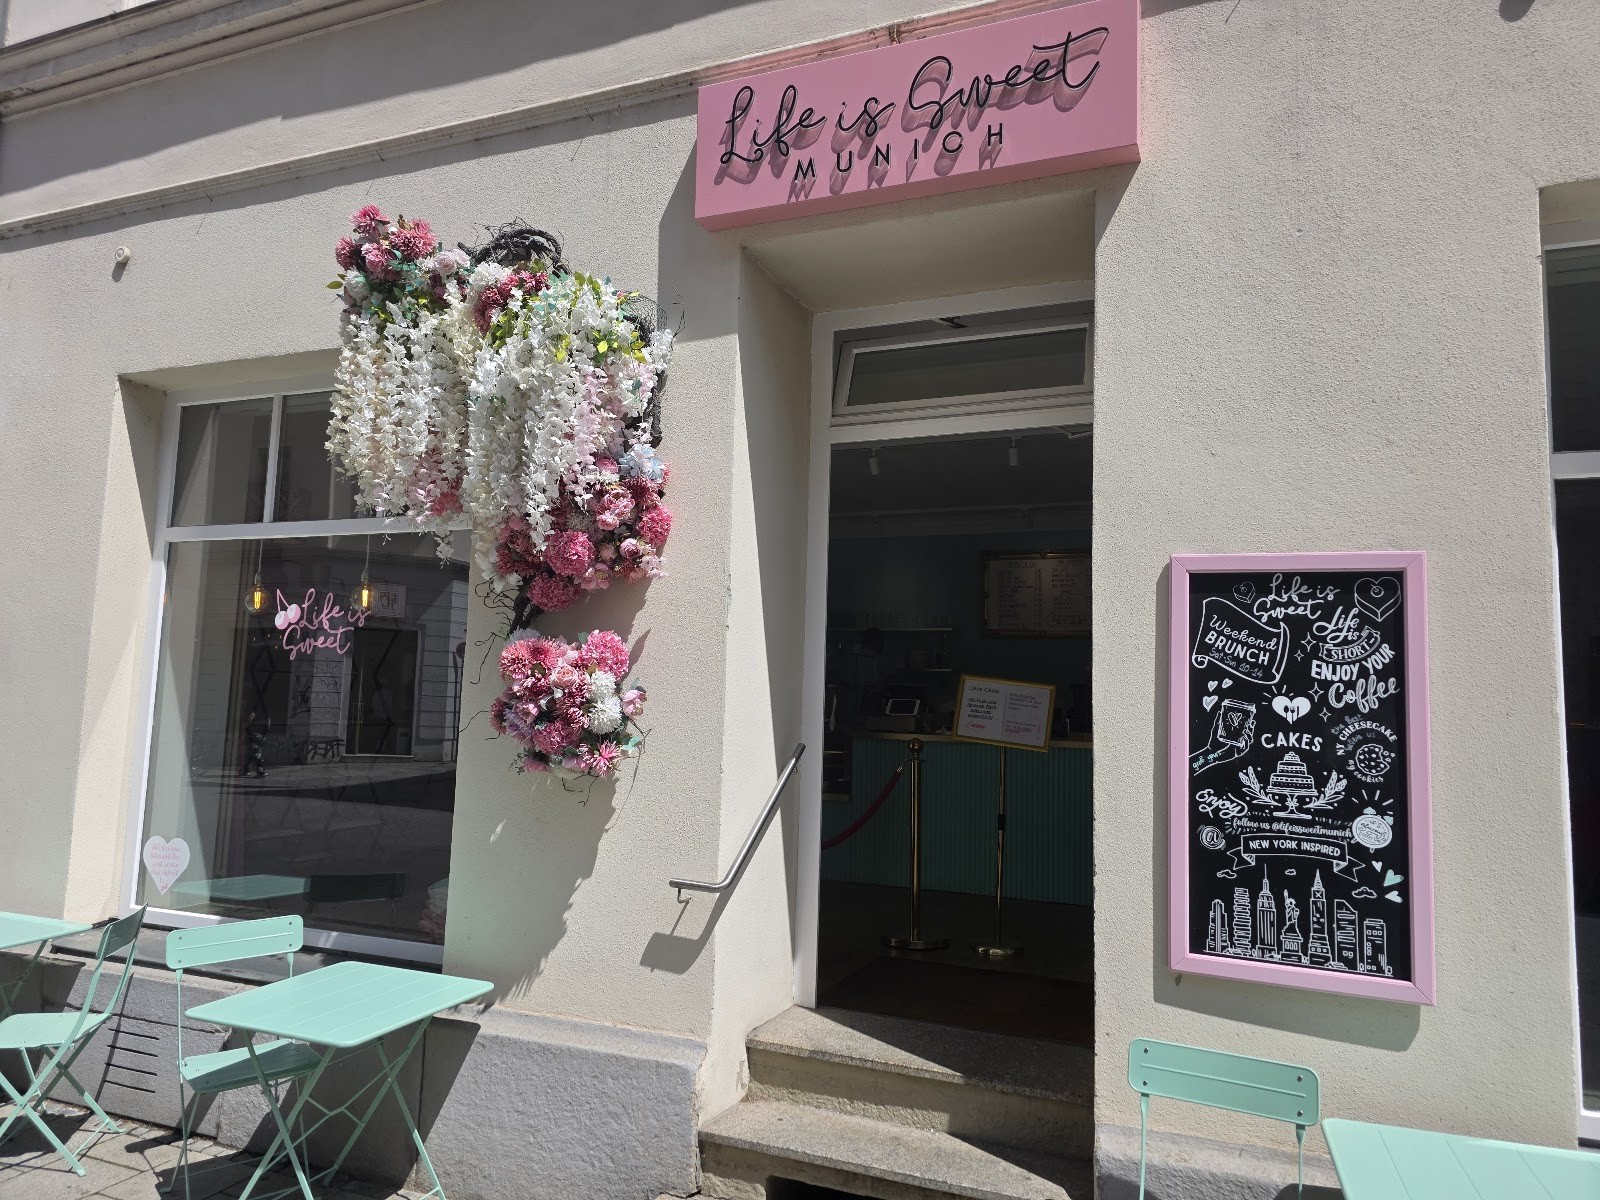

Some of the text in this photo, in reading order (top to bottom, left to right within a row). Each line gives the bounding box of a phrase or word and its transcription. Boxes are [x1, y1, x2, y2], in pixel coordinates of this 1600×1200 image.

[719, 26, 1109, 165] Life is Sweet
[793, 122, 1004, 182] MUNICH
[1267, 573, 1340, 604] Life is
[299, 588, 371, 630] Life is
[1253, 598, 1324, 623] Sweet
[1209, 614, 1277, 650] Weekend
[1312, 606, 1360, 644] Life
[1347, 628, 1360, 640] is
[282, 624, 355, 660] Sweet
[1204, 630, 1270, 666] BRUNCH
[1311, 643, 1396, 682] ENJOY YOUR
[1328, 674, 1400, 713] Coffee
[1260, 731, 1323, 752] CAKES
[1339, 720, 1398, 742] CHEESECAKE
[1335, 742, 1346, 756] NY
[1353, 770, 1384, 783] cookies
[1195, 788, 1248, 819] Enjoy
[1232, 817, 1259, 829] follow
[1260, 822, 1271, 830] us
[1271, 821, 1353, 838] @lifeissweetmunich
[1248, 839, 1341, 857] NEW YORK INSPIRED
